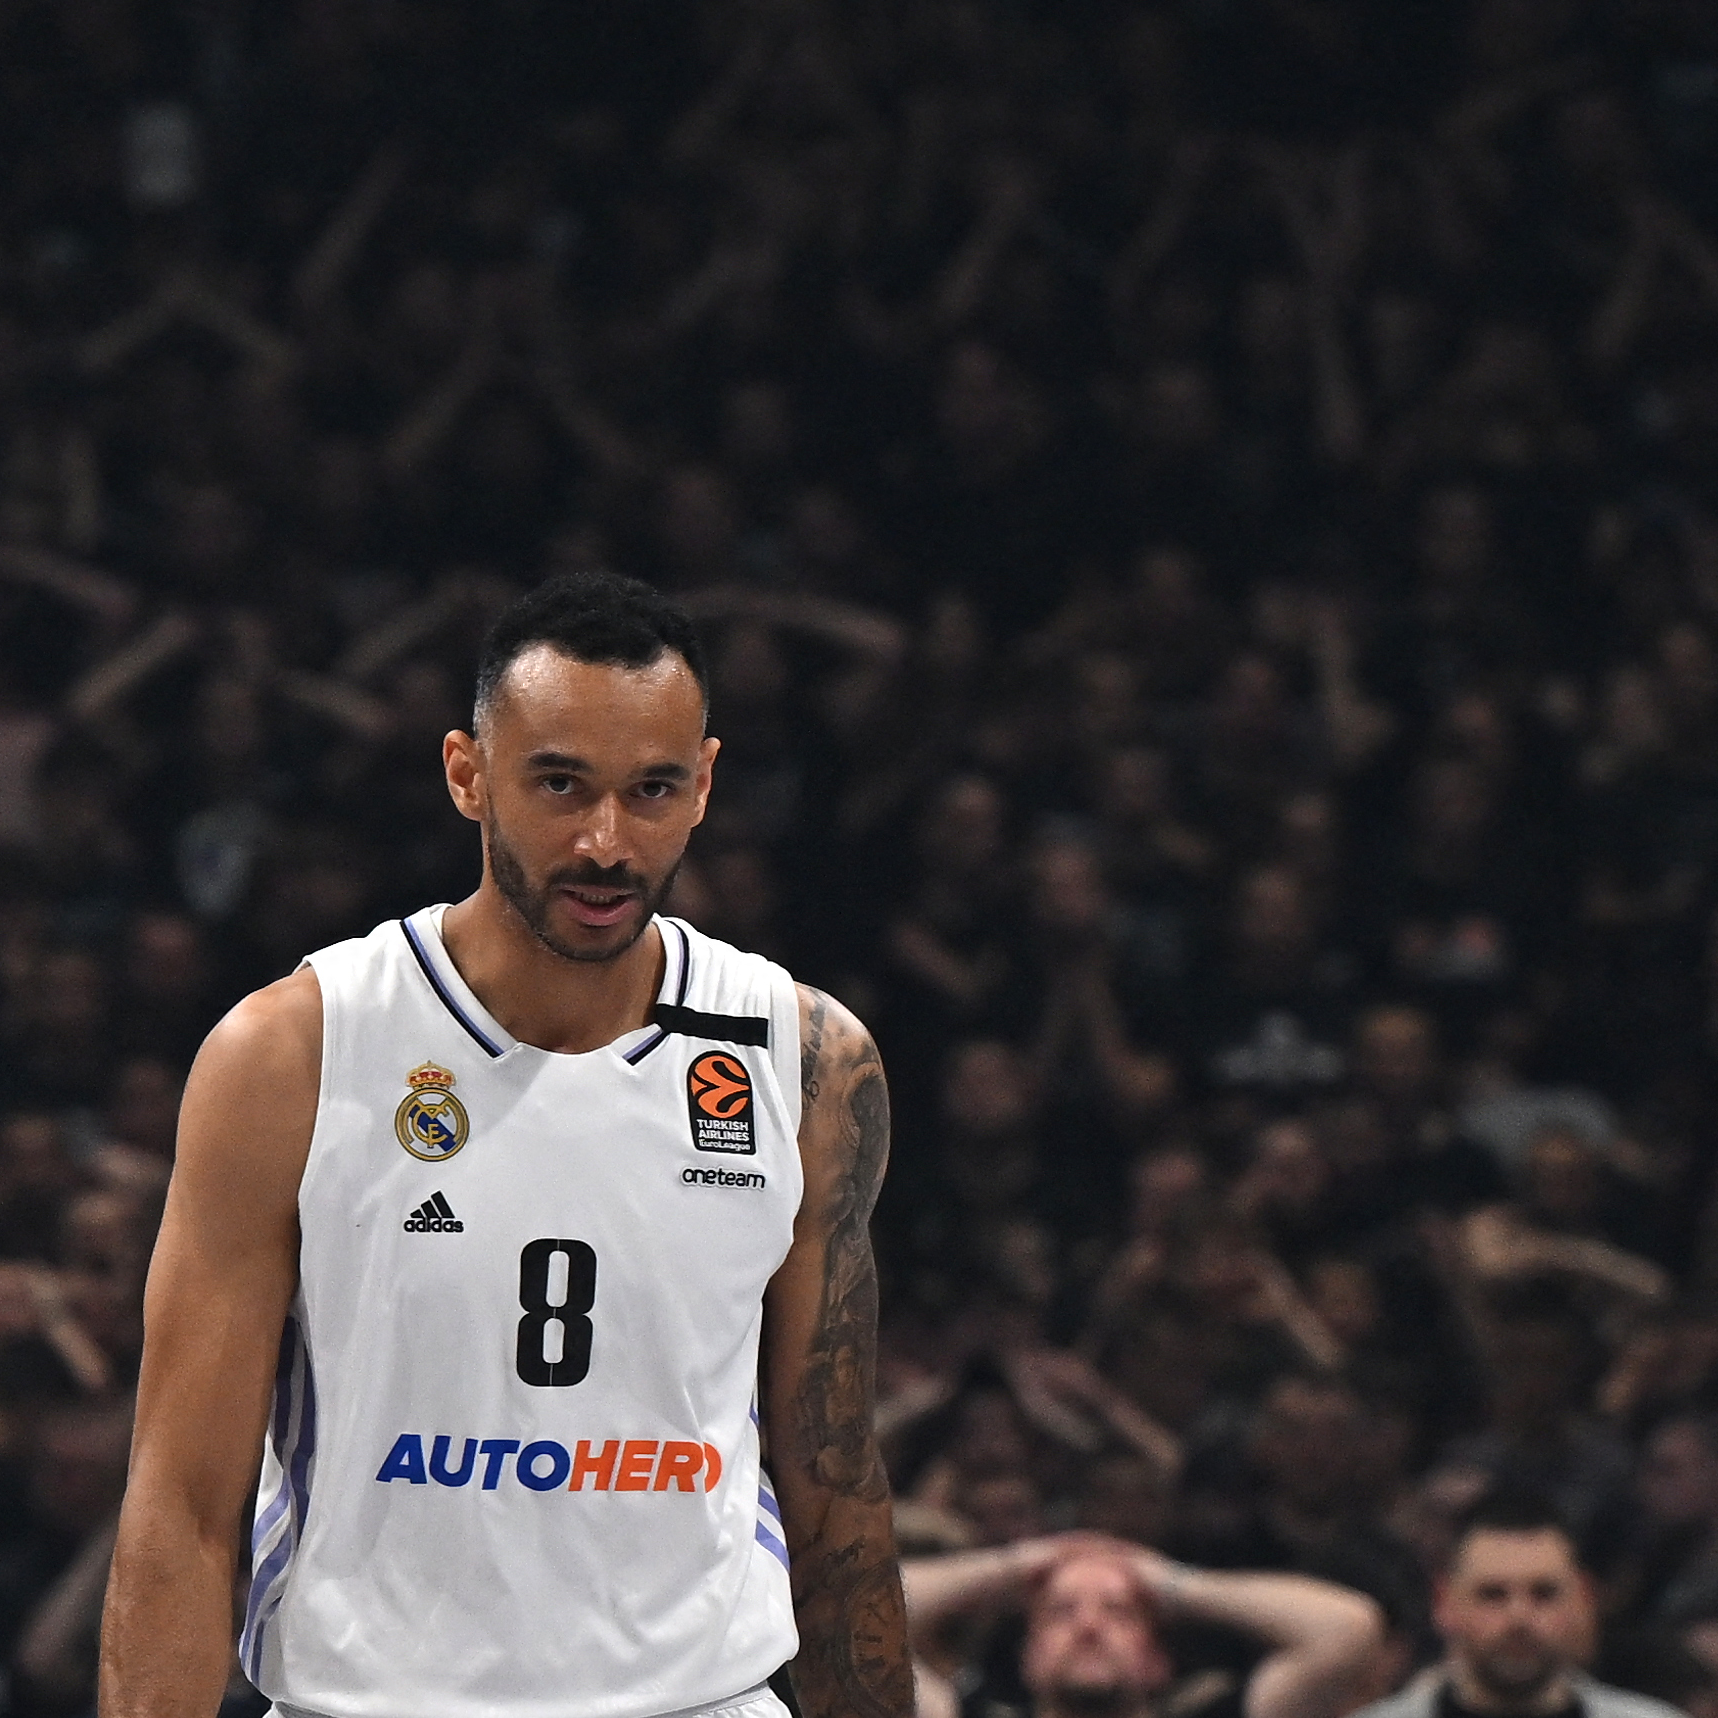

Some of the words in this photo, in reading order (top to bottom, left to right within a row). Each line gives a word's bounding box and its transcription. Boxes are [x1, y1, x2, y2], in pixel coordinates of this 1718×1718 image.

[696, 1118, 749, 1132] TURKISH
[698, 1130, 750, 1142] AIRLINES
[682, 1168, 766, 1189] oneteam
[403, 1217, 464, 1233] adidas
[516, 1238, 598, 1387] 8
